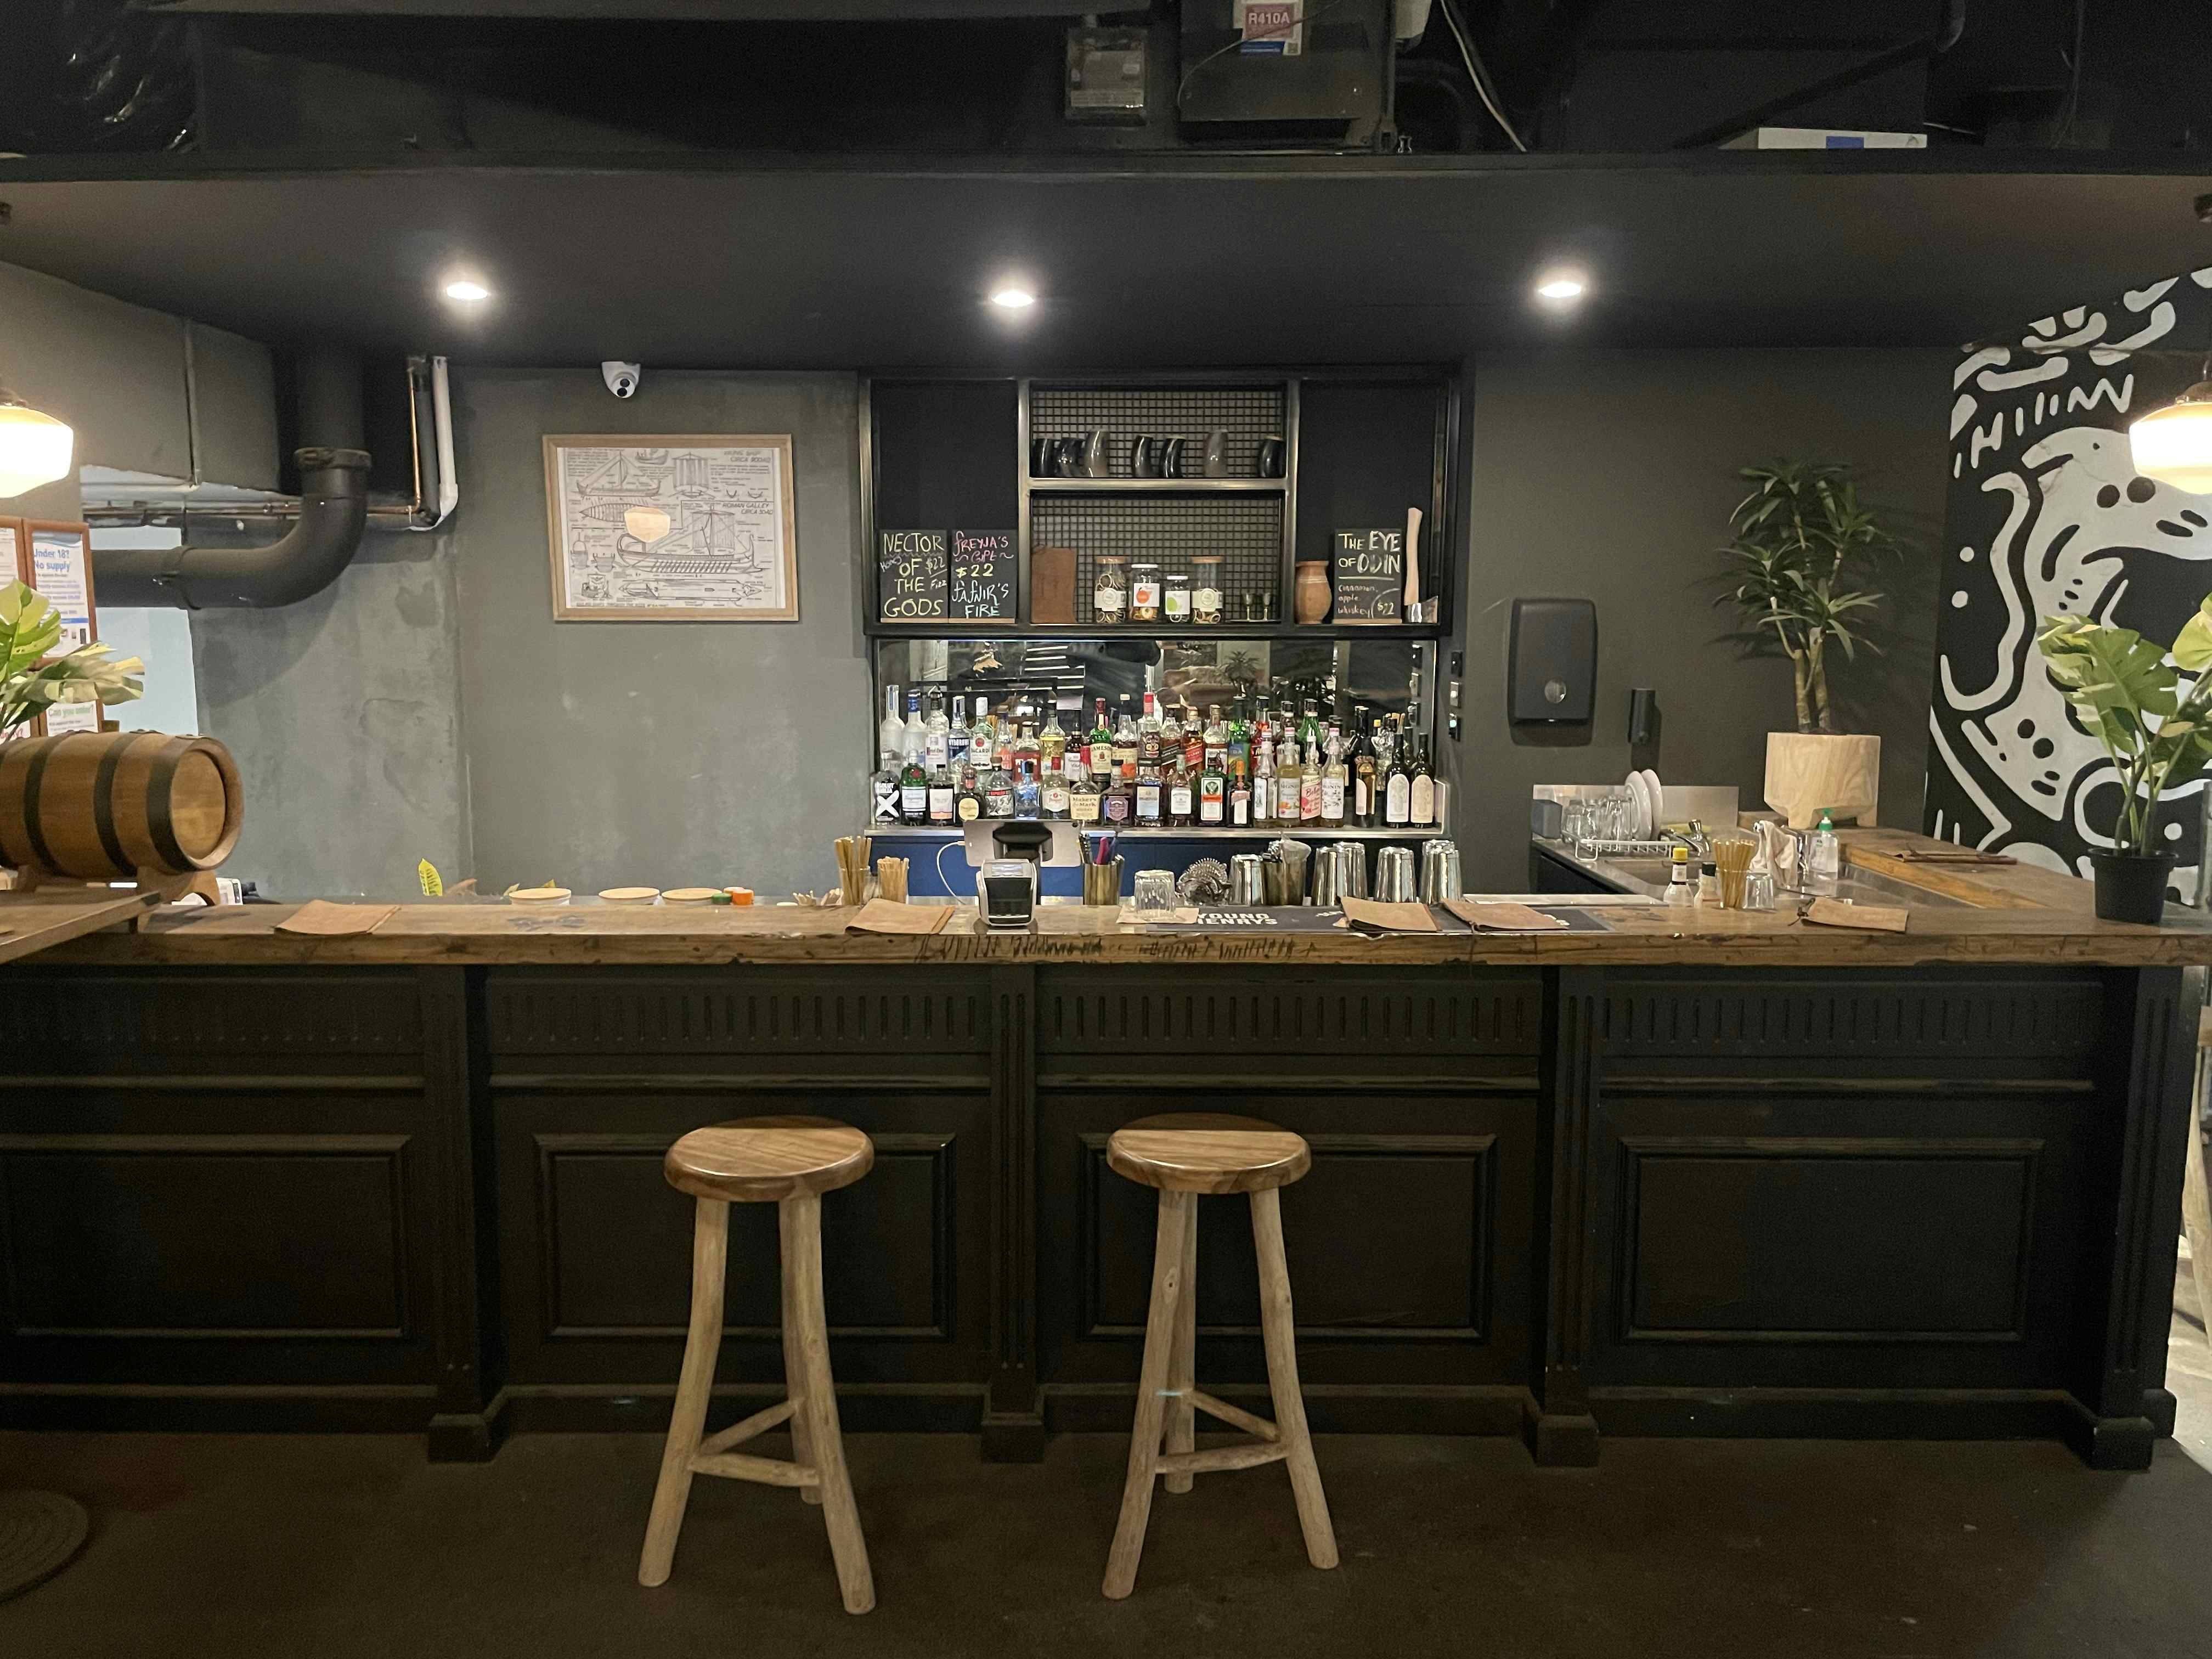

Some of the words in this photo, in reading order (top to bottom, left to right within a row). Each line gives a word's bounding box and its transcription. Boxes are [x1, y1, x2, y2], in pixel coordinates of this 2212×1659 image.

[1248, 13, 1290, 25] R410A
[884, 533, 944, 554] NECTOR
[1369, 531, 1401, 552] EYE
[58, 549, 70, 558] 18?
[47, 562, 70, 572] supply
[899, 558, 922, 576] OF
[925, 556, 946, 574] $22
[955, 563, 994, 578] $22
[1338, 557, 1357, 568] OF
[1357, 553, 1401, 574] ODIN
[894, 577, 926, 594] THE
[884, 597, 944, 617] GODS
[965, 603, 1000, 619] FIRE
[1377, 600, 1395, 616] $22
